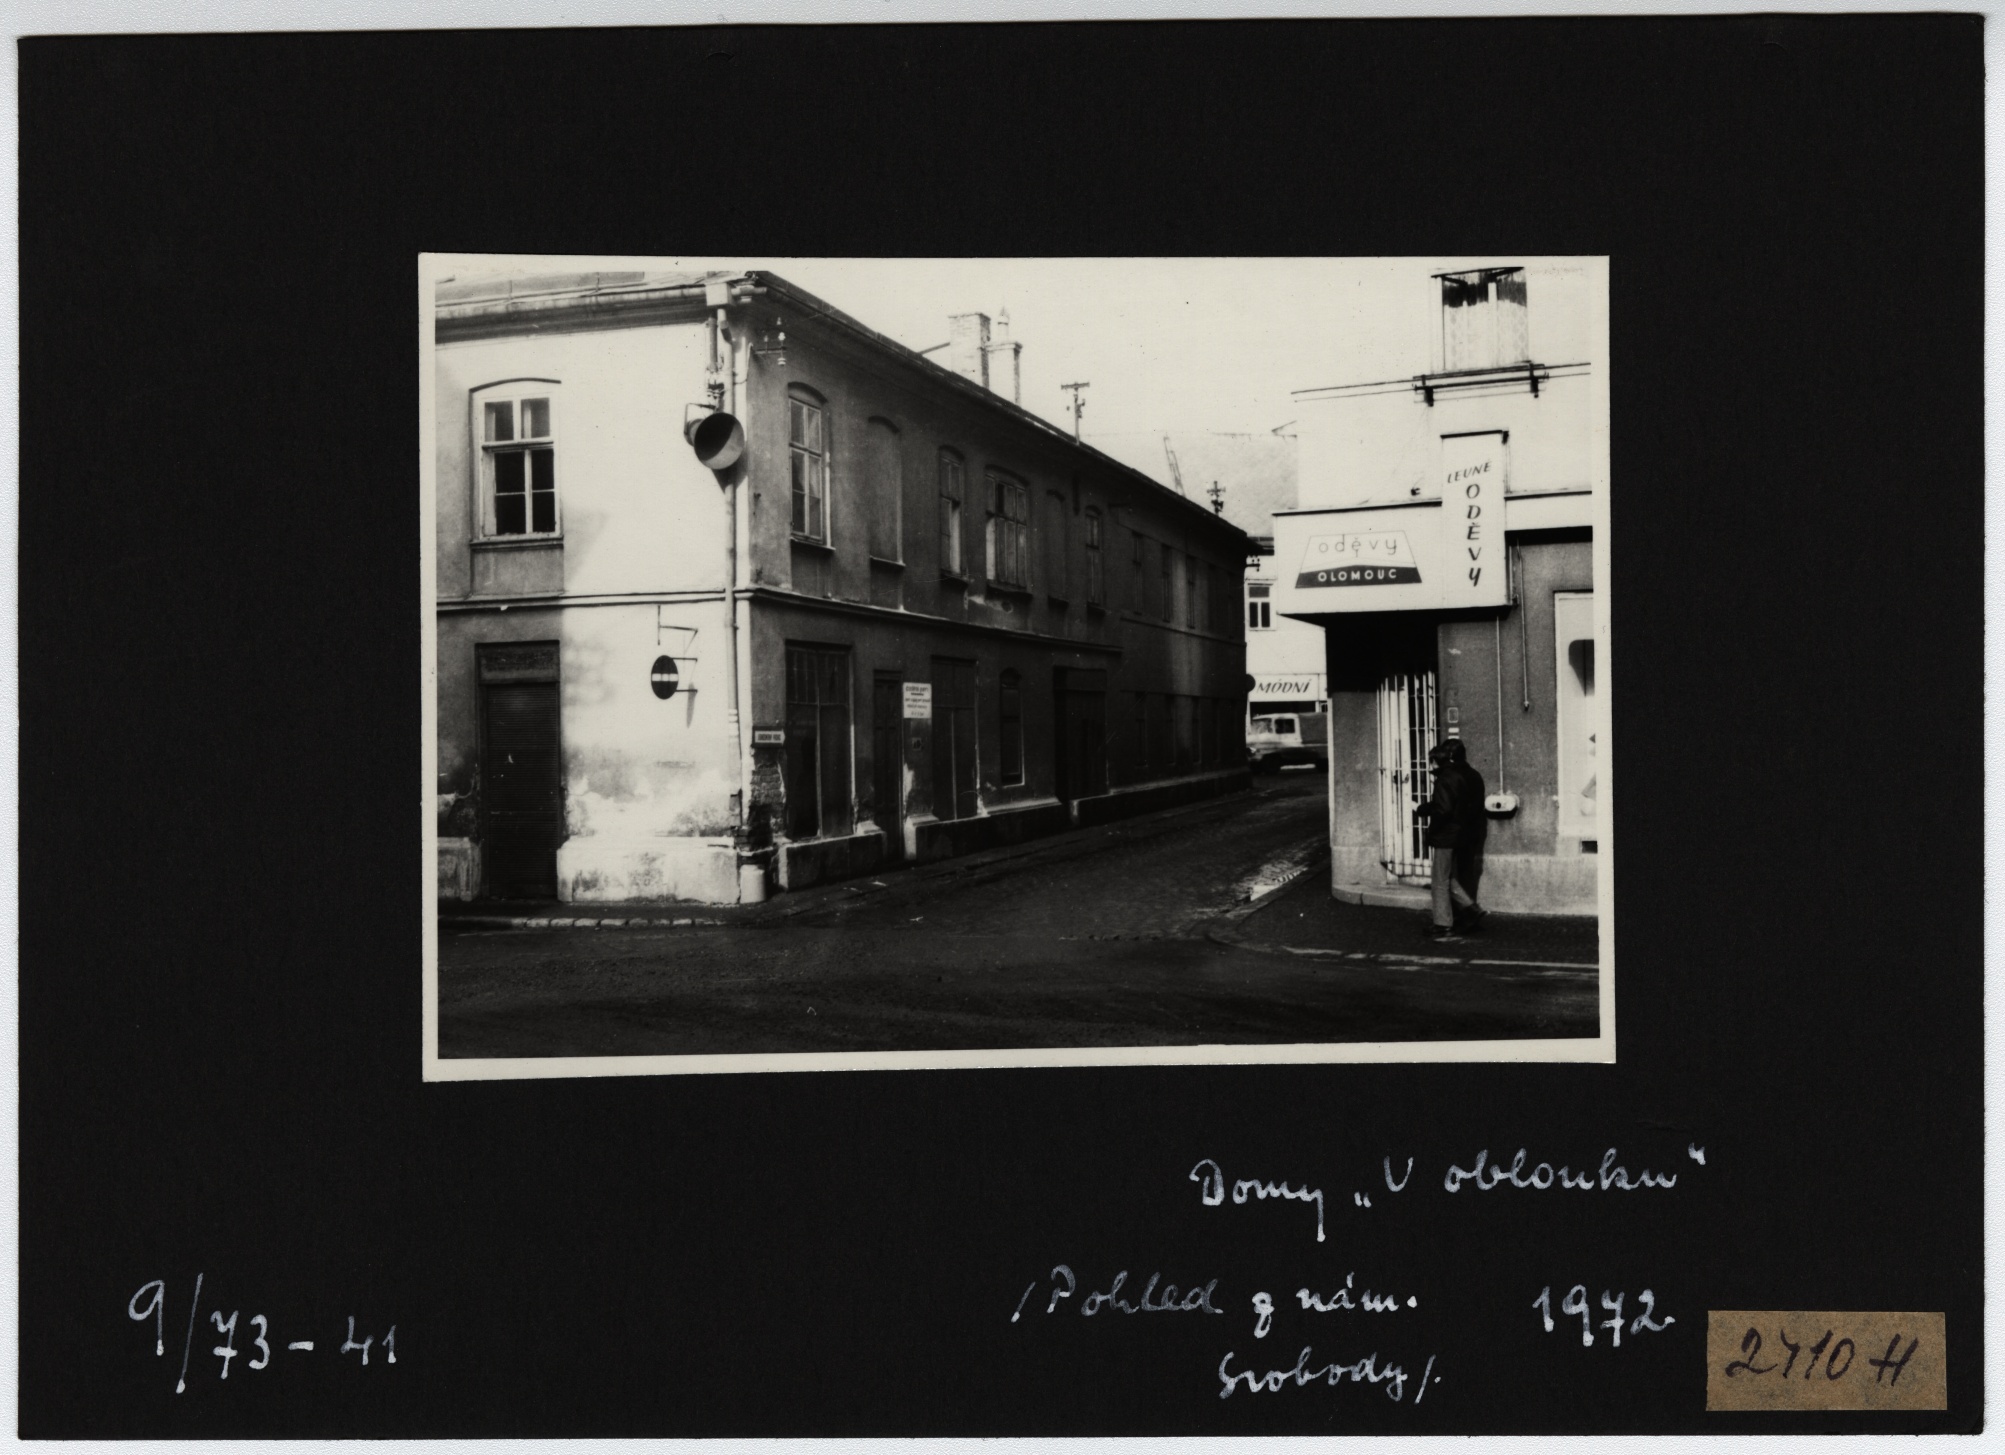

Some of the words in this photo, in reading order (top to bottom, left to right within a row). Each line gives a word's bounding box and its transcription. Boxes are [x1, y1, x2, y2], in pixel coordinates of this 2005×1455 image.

[1318, 534, 1398, 557] oděvy
[1465, 483, 1482, 588] ODĚVY
[1317, 568, 1398, 583] OLOMOUC
[1256, 679, 1312, 694] MÓDNÍ
[1189, 1158, 1326, 1243] Domy
[1252, 1291, 1275, 1339] z
[1296, 1271, 1418, 1313] nám.
